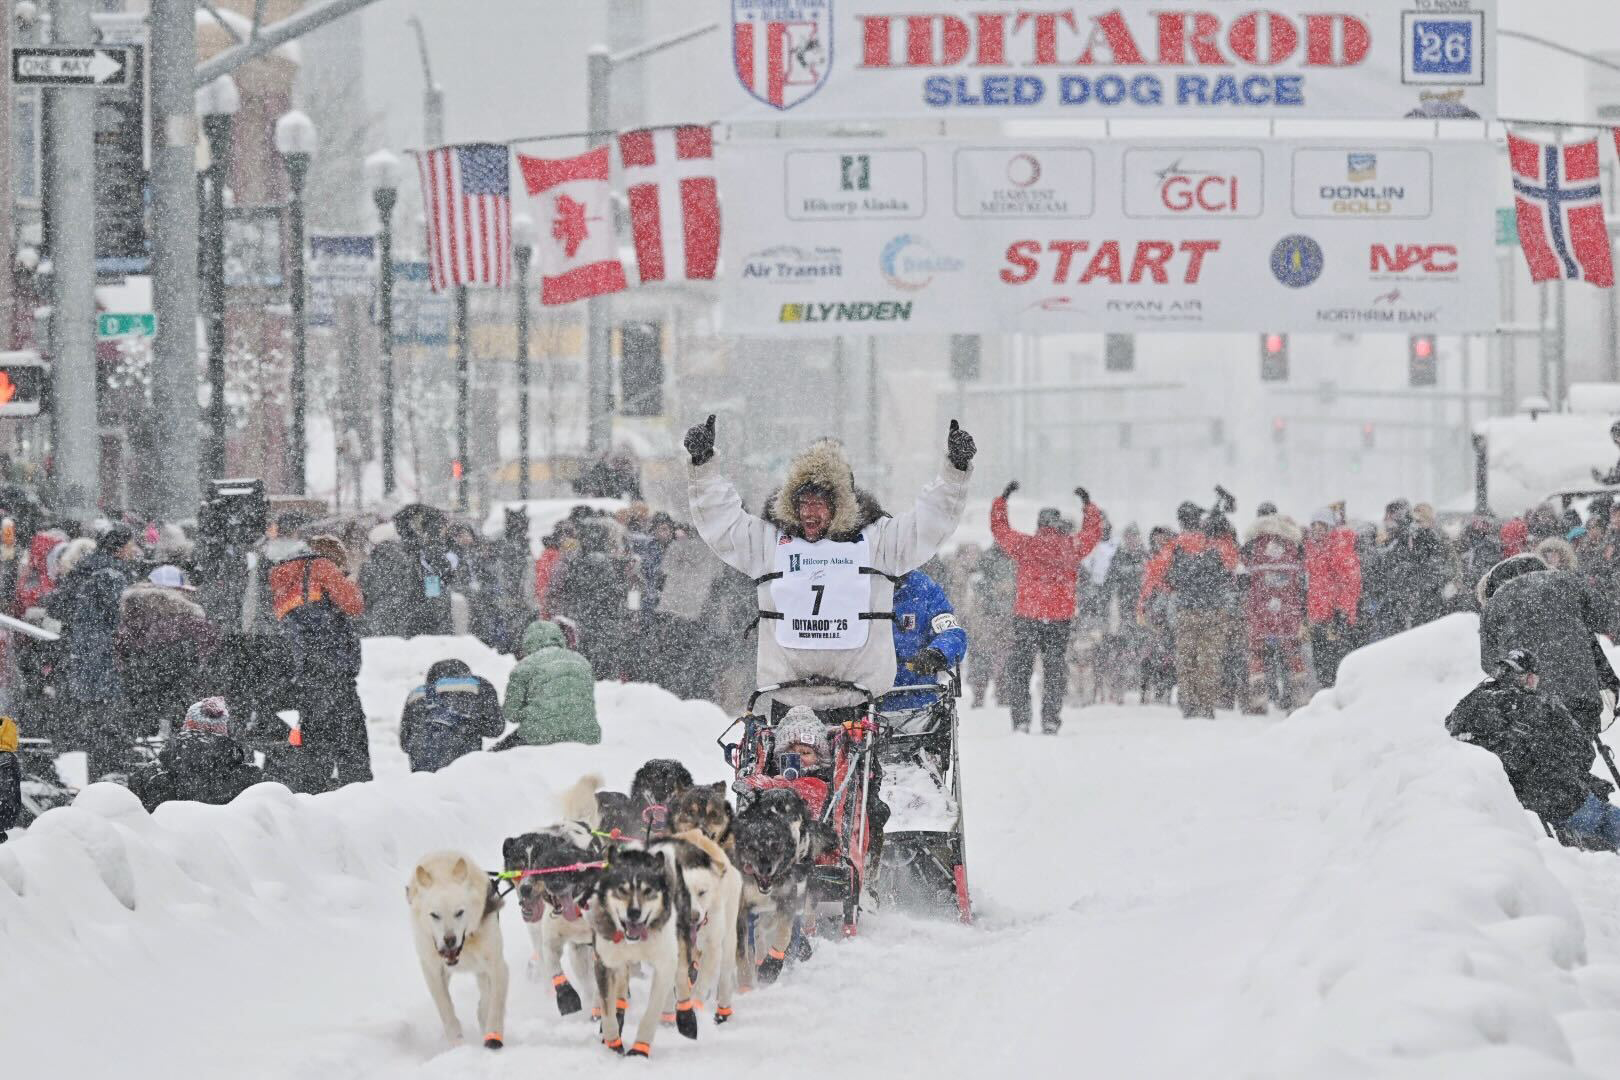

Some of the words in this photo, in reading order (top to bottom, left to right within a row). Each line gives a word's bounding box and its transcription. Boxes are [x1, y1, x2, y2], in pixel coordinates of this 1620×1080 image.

[855, 9, 1372, 69] IDITAROD
[23, 60, 50, 74] ONE
[60, 60, 91, 74] WAY
[923, 73, 1046, 107] SLED
[1058, 73, 1163, 107] DOG
[1175, 73, 1305, 107] RACE
[1161, 175, 1238, 212] GCI
[1319, 185, 1405, 200] DONLIN
[803, 198, 857, 214] Hilcorp
[862, 198, 910, 212] Alaska
[1331, 201, 1392, 214] GOLD
[999, 239, 1222, 285] START
[743, 263, 773, 278] Air
[776, 263, 843, 278] Transit
[804, 301, 913, 322] LYNDEN
[1171, 300, 1203, 312] AIR
[1398, 308, 1438, 322] BANK
[802, 557, 828, 566] Hilcorp
[830, 557, 854, 565] Alaska
[811, 584, 825, 616] 7
